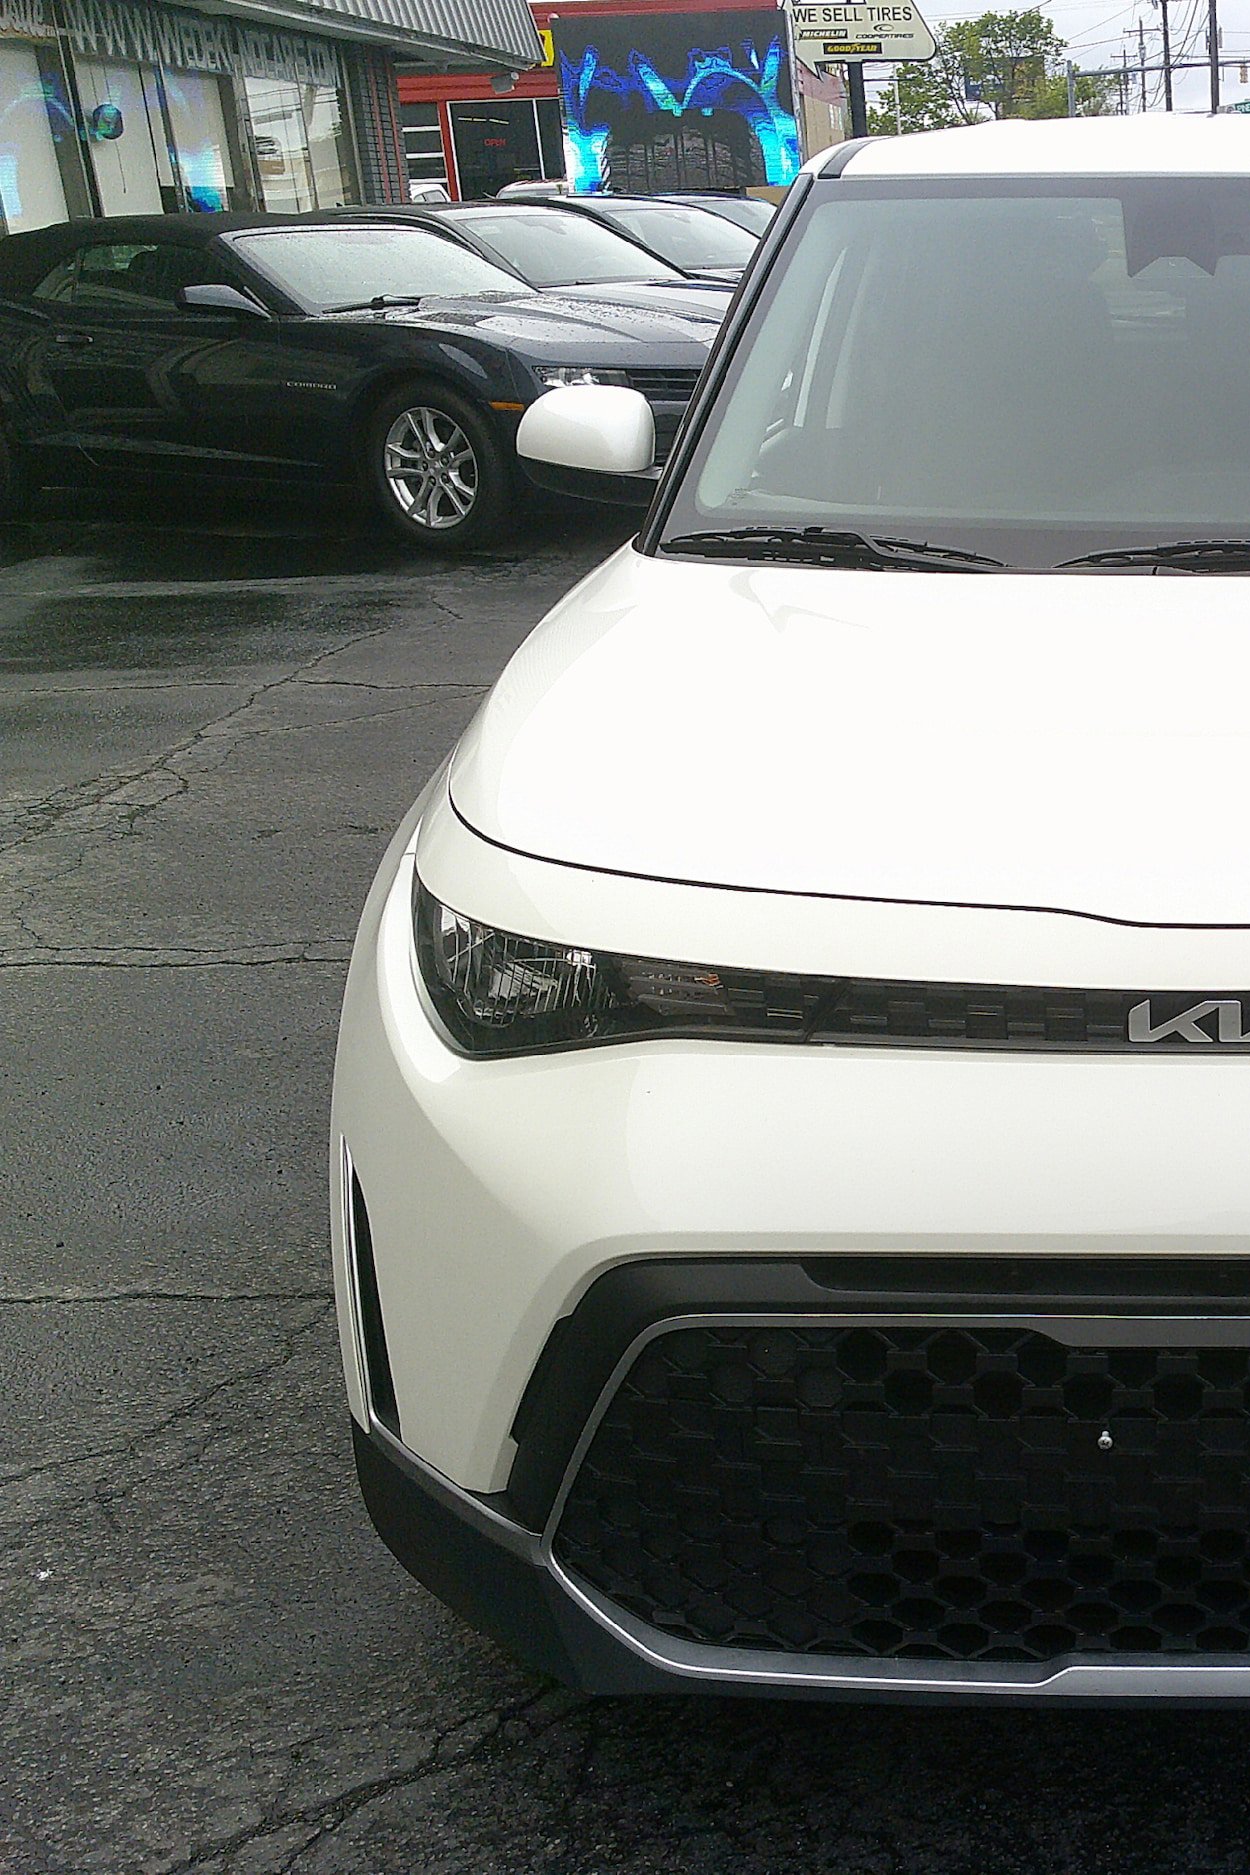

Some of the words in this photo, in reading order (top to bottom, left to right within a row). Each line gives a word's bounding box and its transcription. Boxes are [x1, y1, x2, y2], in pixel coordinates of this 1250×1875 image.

[792, 8, 817, 22] WE
[822, 7, 863, 22] SELL
[867, 6, 912, 21] TIRES
[801, 30, 847, 38] MICHELIN
[827, 43, 877, 53] GOODYEAR
[484, 138, 506, 147] OPEN
[286, 381, 338, 390] CAMARO
